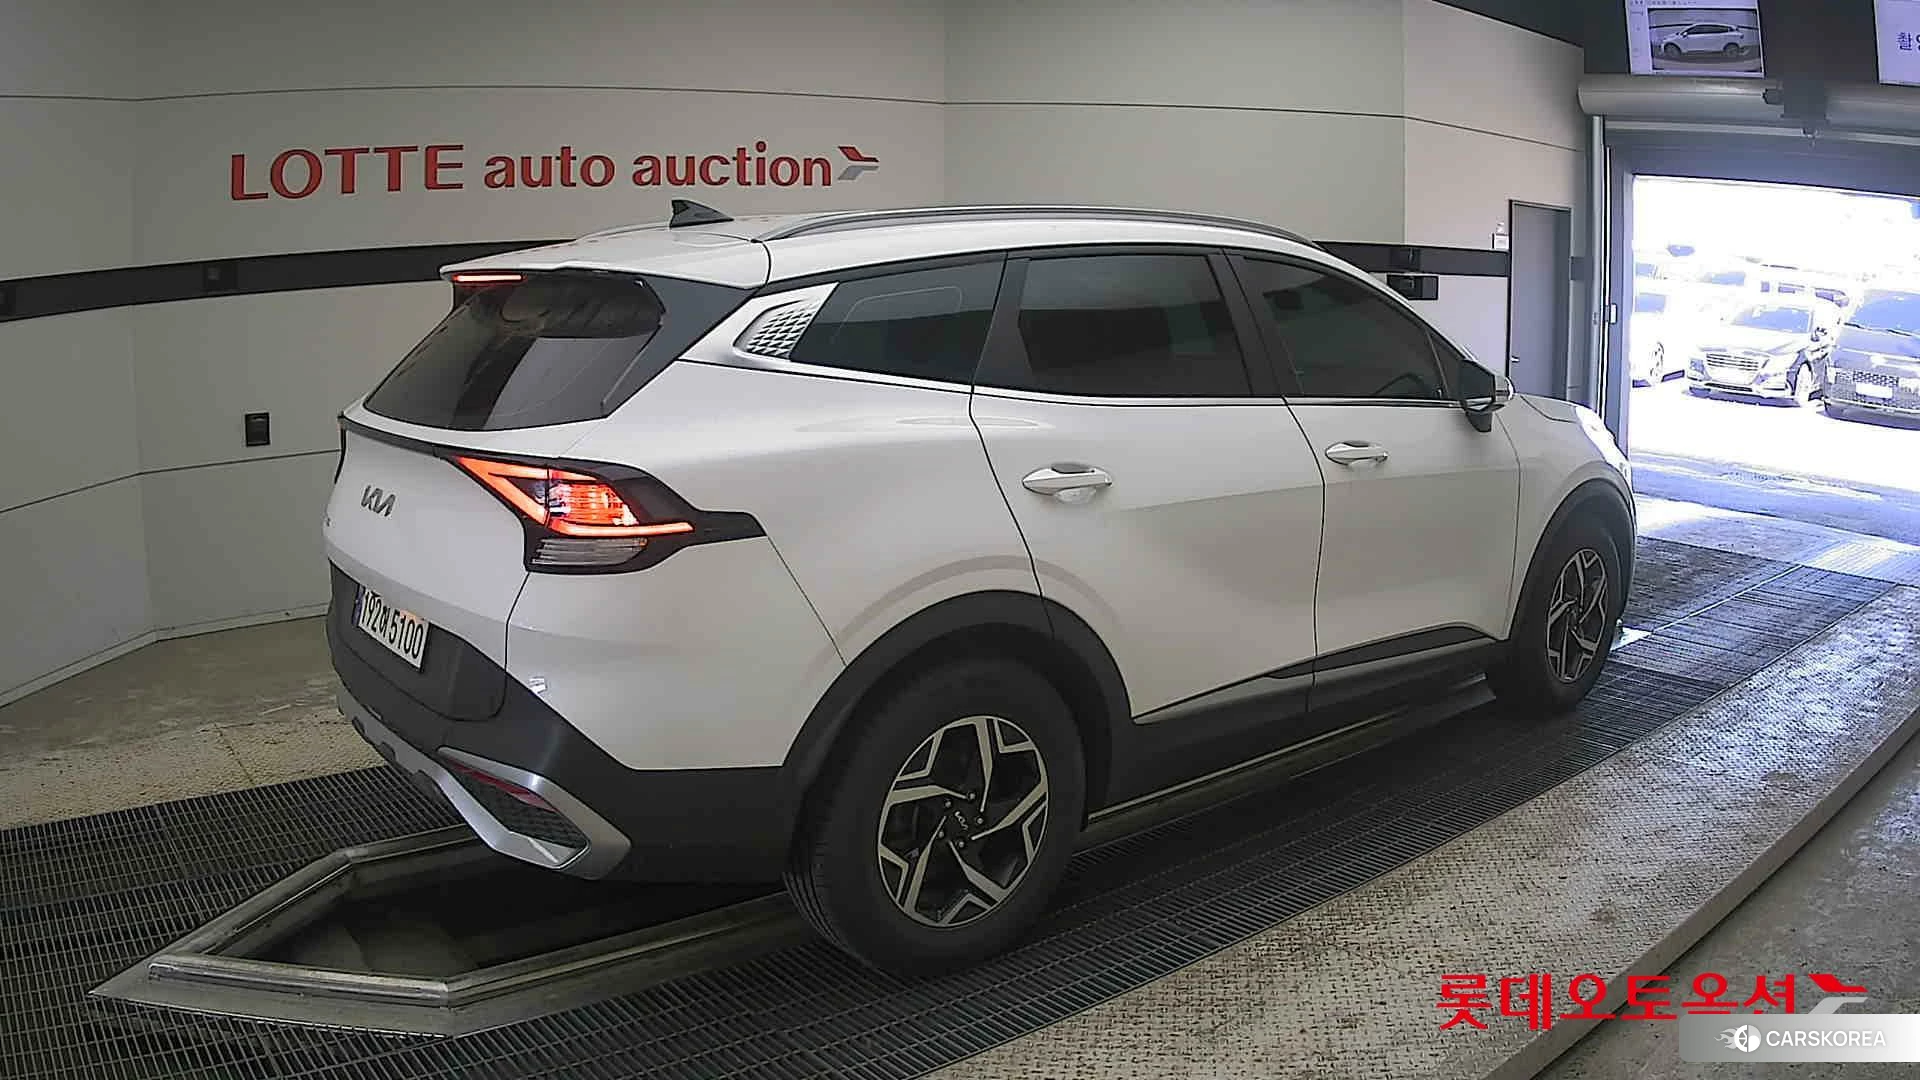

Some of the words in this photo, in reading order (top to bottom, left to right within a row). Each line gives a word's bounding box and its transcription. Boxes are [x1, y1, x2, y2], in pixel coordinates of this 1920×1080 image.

[231, 144, 465, 201] LOTTE
[483, 145, 616, 189] auto
[631, 140, 832, 188] auction
